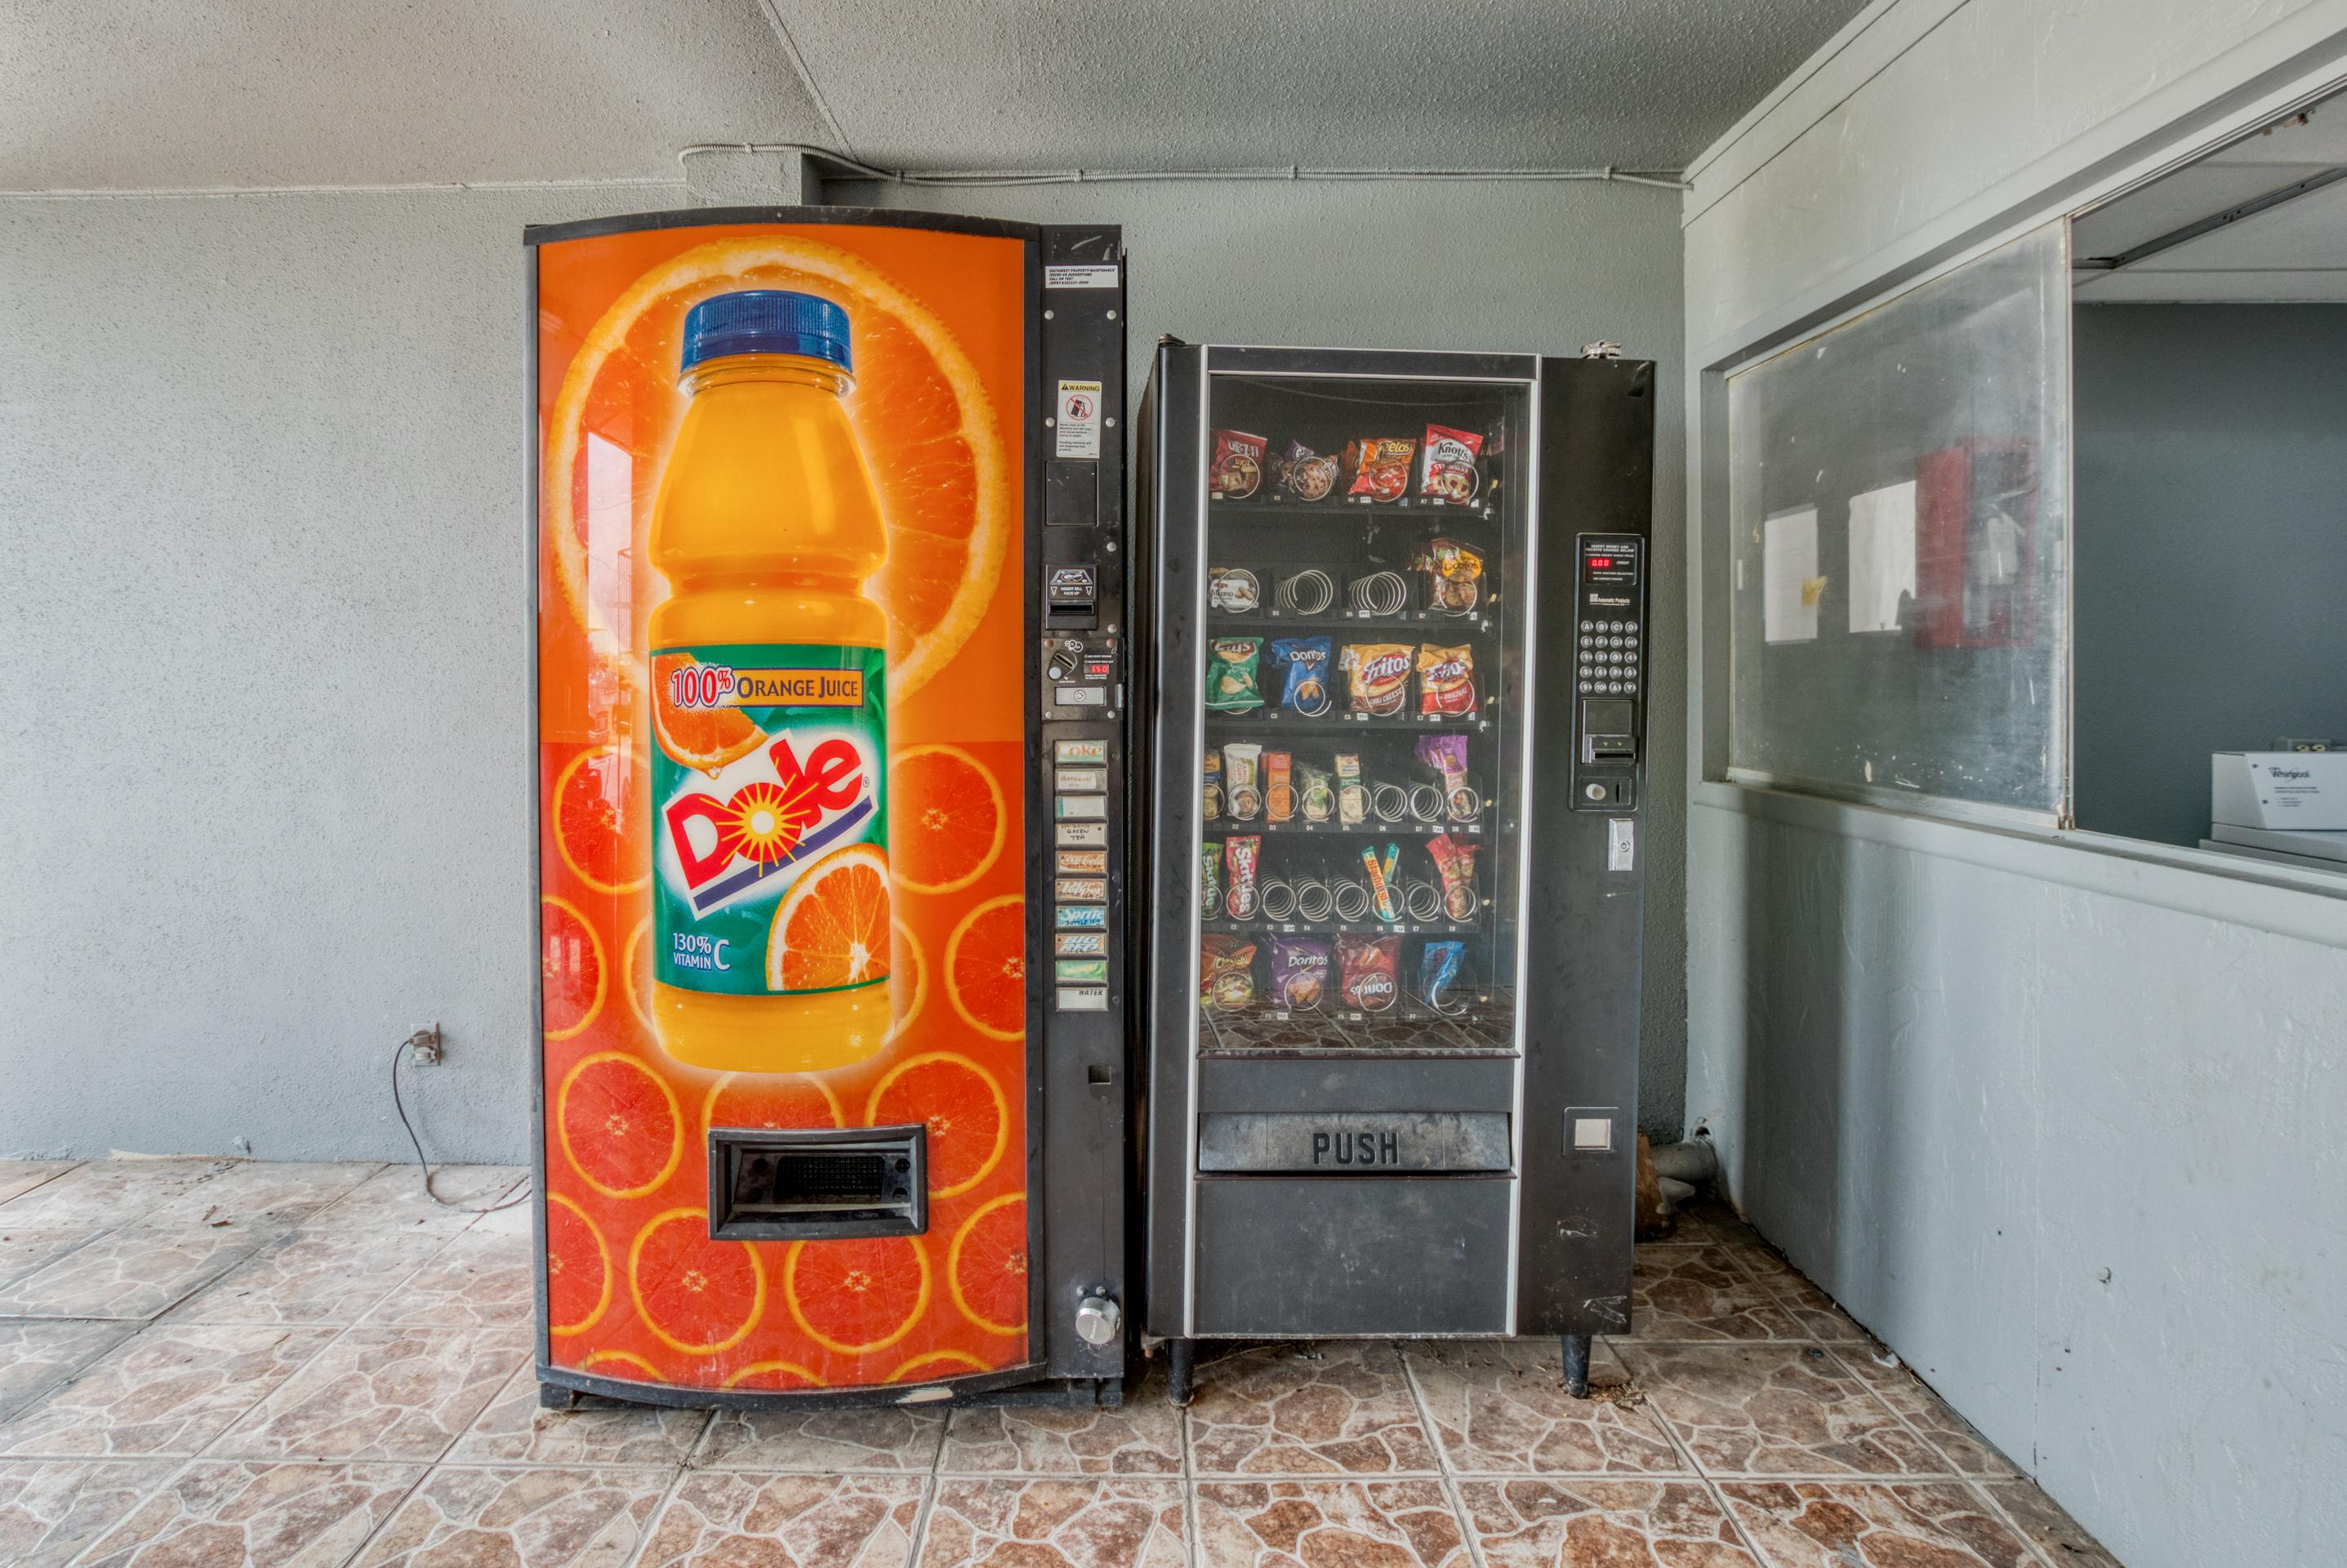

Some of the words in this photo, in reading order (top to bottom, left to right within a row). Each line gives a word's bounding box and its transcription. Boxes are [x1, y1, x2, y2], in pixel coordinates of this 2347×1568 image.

[1437, 442, 1468, 461] Knott's
[1592, 559, 1610, 567] 0.00
[1289, 649, 1326, 662] Doritos
[1363, 655, 1410, 684] Fritos
[672, 667, 734, 707] 100%
[737, 676, 815, 699] ORANGE
[817, 675, 858, 699] JUICE
[1383, 687, 1404, 702] CHEESE
[1443, 686, 1467, 700] ORIGINAL
[2270, 770, 2309, 780] Whirlpool
[666, 738, 864, 891] Dole
[1235, 848, 1254, 915] Skittles
[1367, 859, 1387, 902] Starburst
[1061, 908, 1104, 921] Sprite
[673, 933, 712, 953] 130%
[1063, 936, 1099, 944] BIG
[674, 951, 711, 971] VITAMIN
[713, 938, 731, 971] C
[1288, 955, 1328, 968] Doritos
[1350, 982, 1392, 995] Doritos
[1312, 1132, 1400, 1165] PUSH
